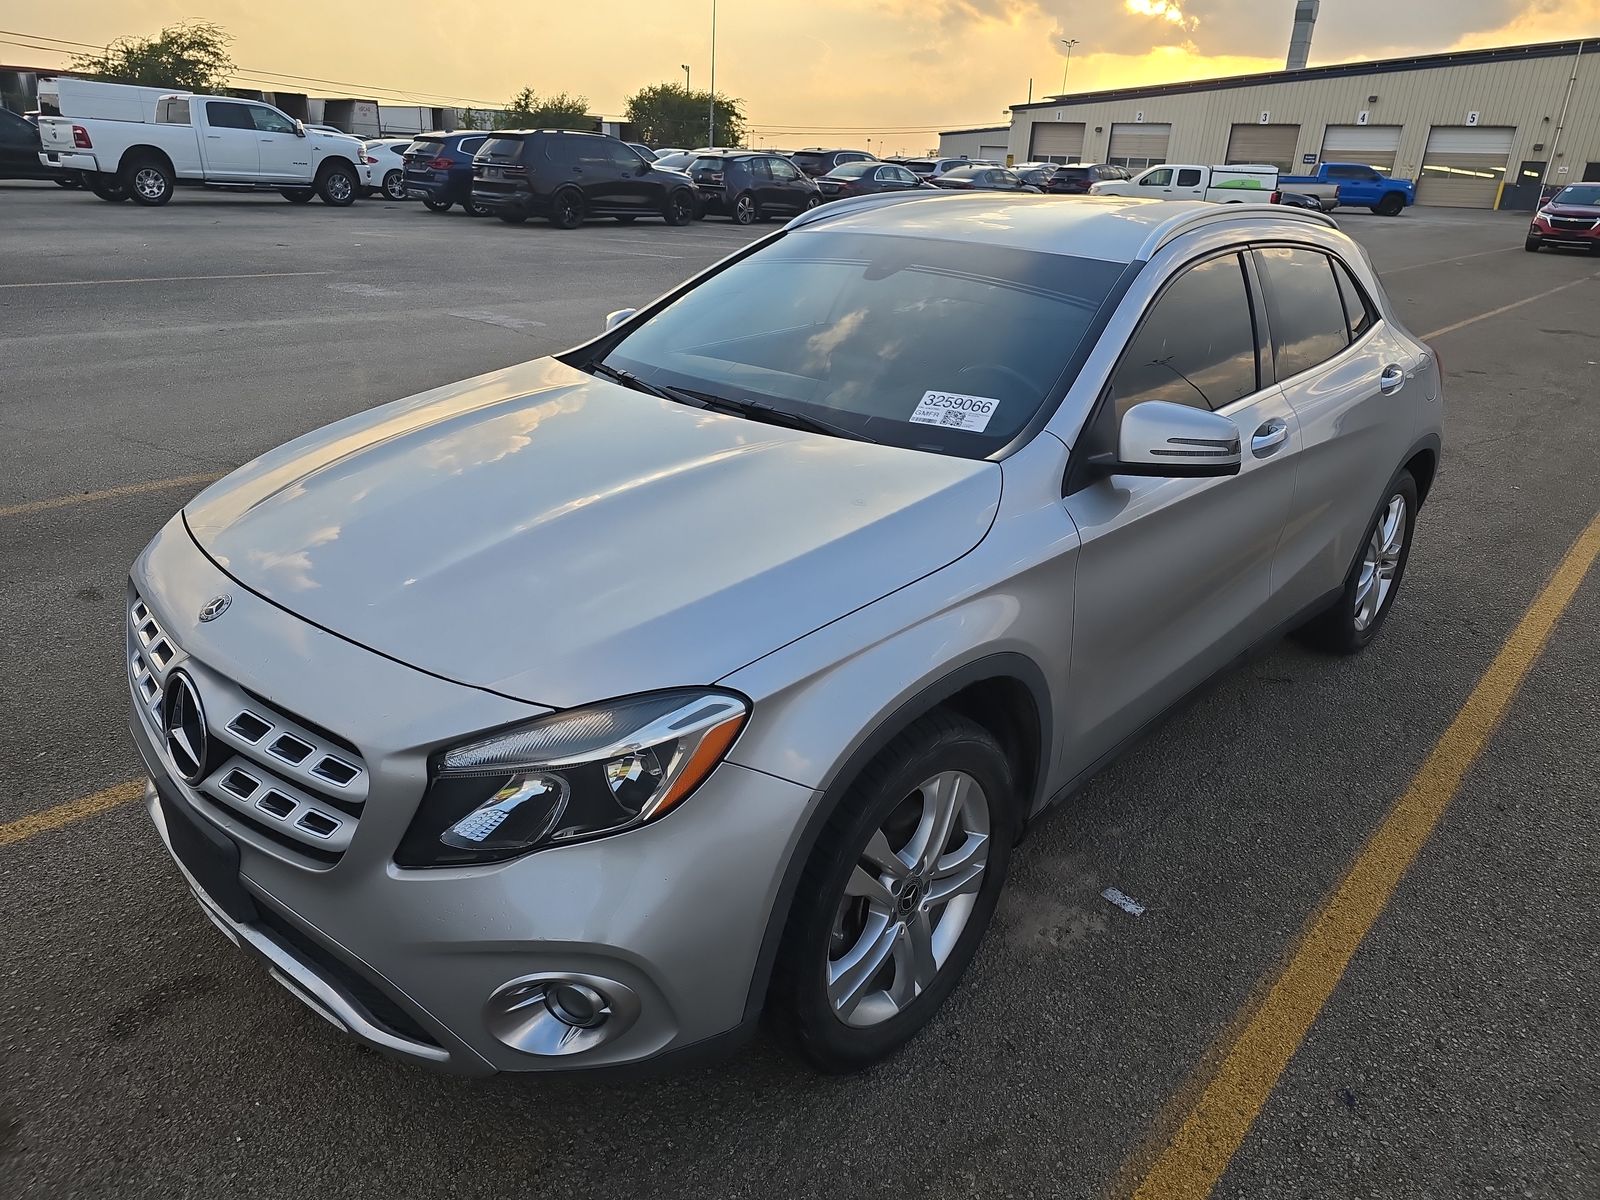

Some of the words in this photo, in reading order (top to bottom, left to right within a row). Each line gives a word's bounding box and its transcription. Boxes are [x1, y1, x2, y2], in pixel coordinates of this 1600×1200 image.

[1137, 112, 1142, 121] 2
[1262, 113, 1268, 122] 3
[1360, 113, 1366, 122] 4
[1469, 113, 1476, 123] 5
[924, 394, 993, 414] 3259066
[914, 409, 940, 418] GMFR
